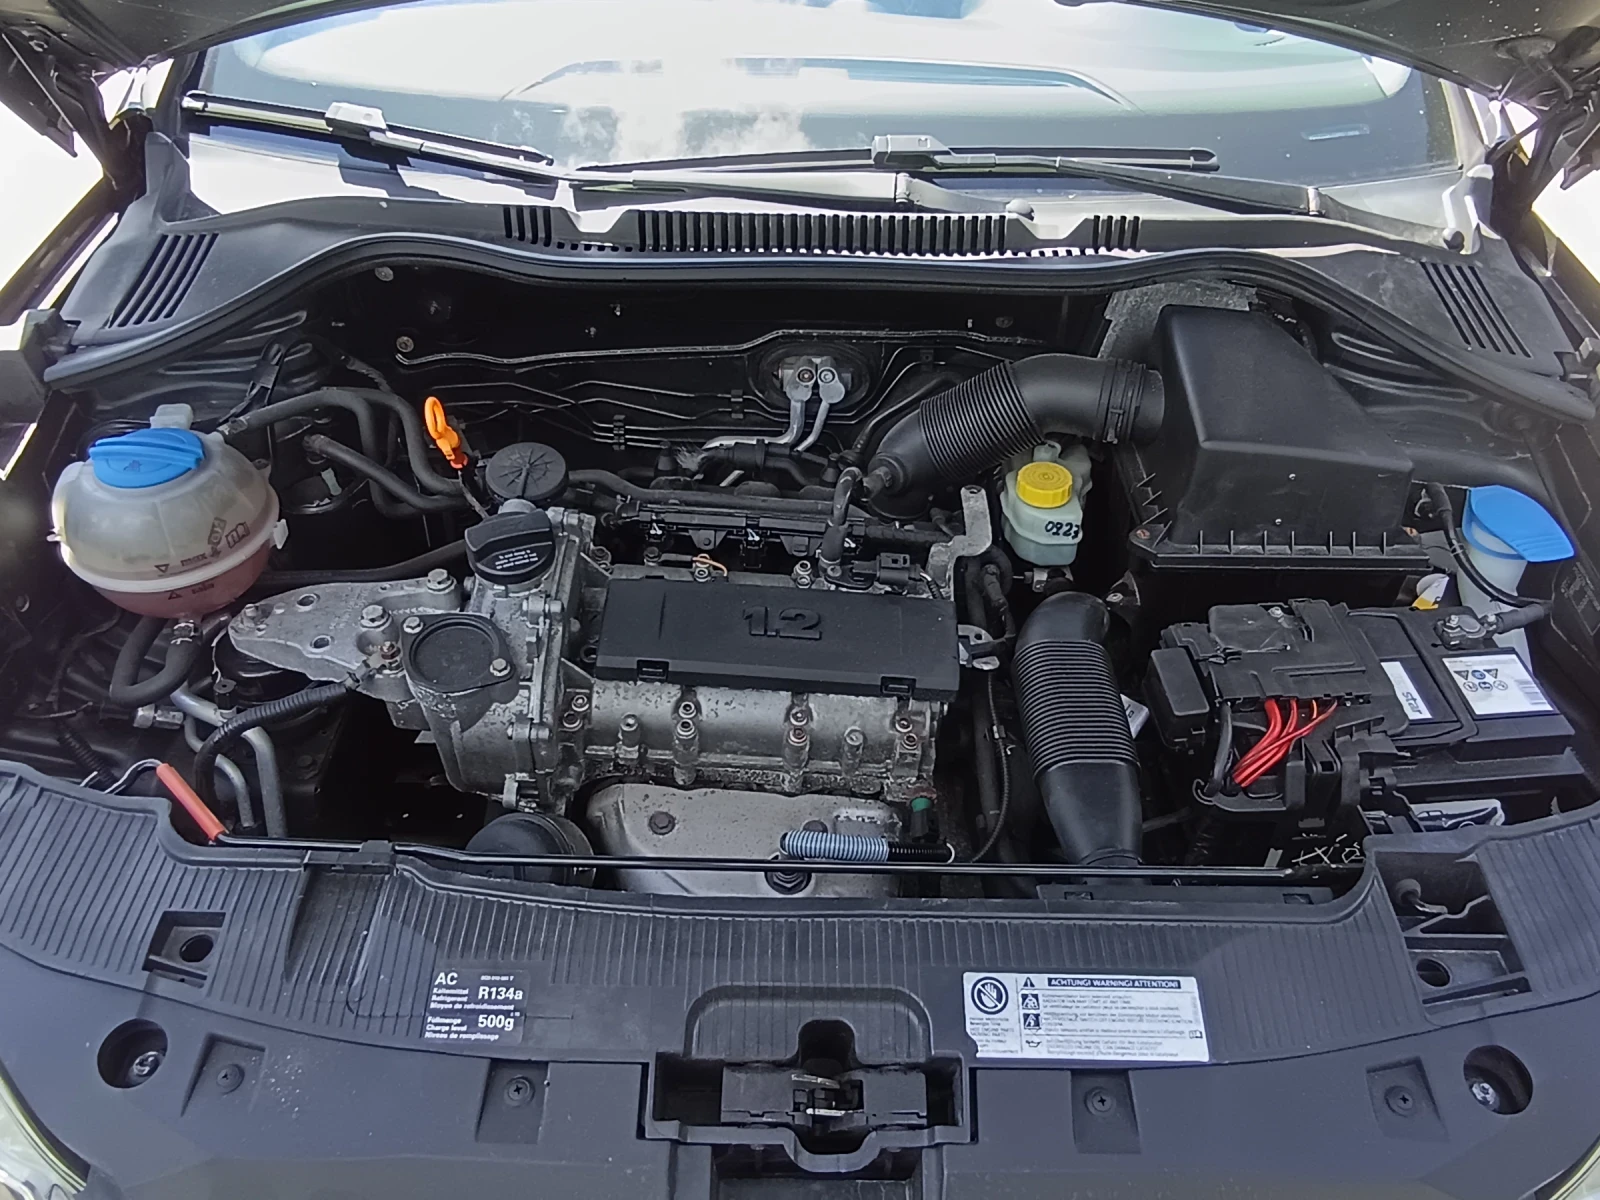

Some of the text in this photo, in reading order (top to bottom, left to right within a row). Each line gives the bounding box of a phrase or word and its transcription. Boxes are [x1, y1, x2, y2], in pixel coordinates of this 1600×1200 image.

[180, 553, 208, 567] max
[742, 605, 822, 641] 1.2
[434, 972, 458, 985] AC
[1050, 978, 1179, 988] ACHTUNG! WARNING! ATTENTION!
[477, 986, 523, 1000] R134a
[477, 1014, 515, 1031] 500g
